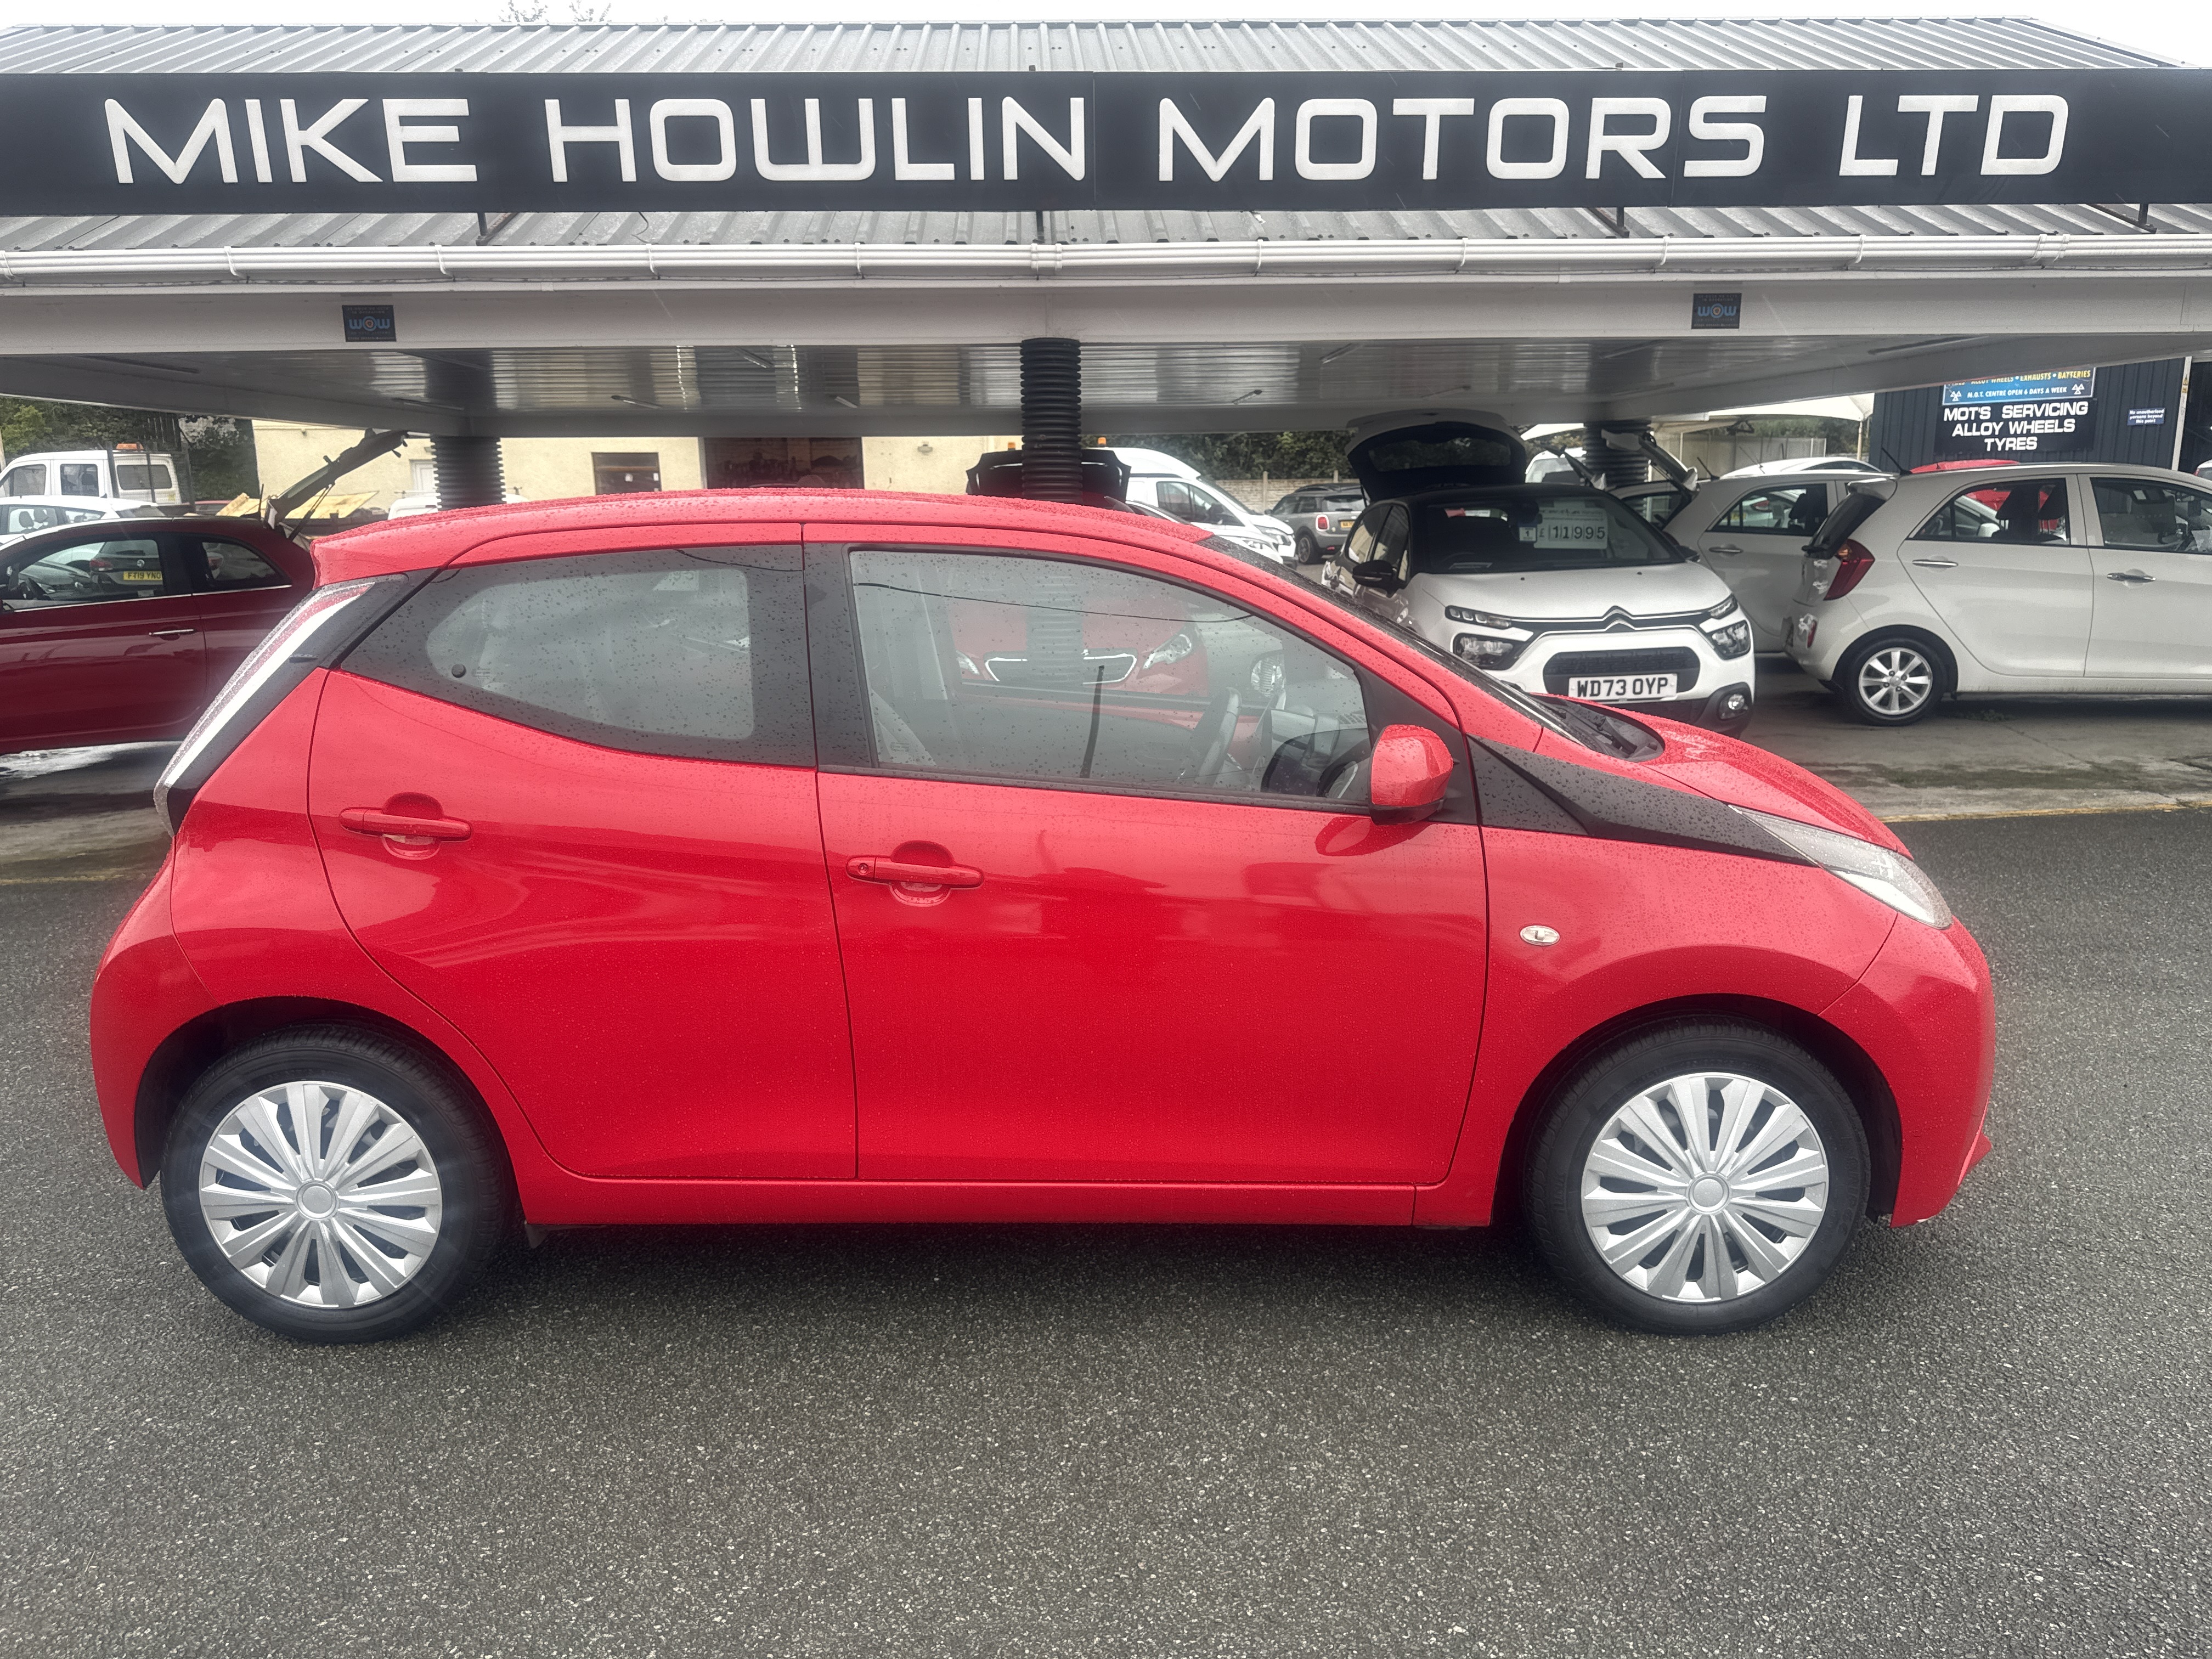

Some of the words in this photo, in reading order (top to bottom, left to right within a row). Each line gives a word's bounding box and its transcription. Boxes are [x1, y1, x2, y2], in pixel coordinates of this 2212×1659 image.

[105, 98, 477, 183] MIKE
[545, 97, 1084, 182] HOWLIN
[1159, 95, 1766, 181] MOTORS
[1839, 95, 2068, 175] LTD
[2020, 373, 2051, 381] EXHAUSTS
[2058, 370, 2091, 379] BATTERIES
[1943, 406, 1991, 421] MOT'S
[2001, 401, 2088, 419] SERVICING
[1952, 421, 2004, 437] ALLOY
[2008, 419, 2075, 435] WHEELS
[1984, 436, 2038, 451] TYRES
[1577, 679, 1627, 697] WD73
[1633, 677, 1668, 695] OYP
